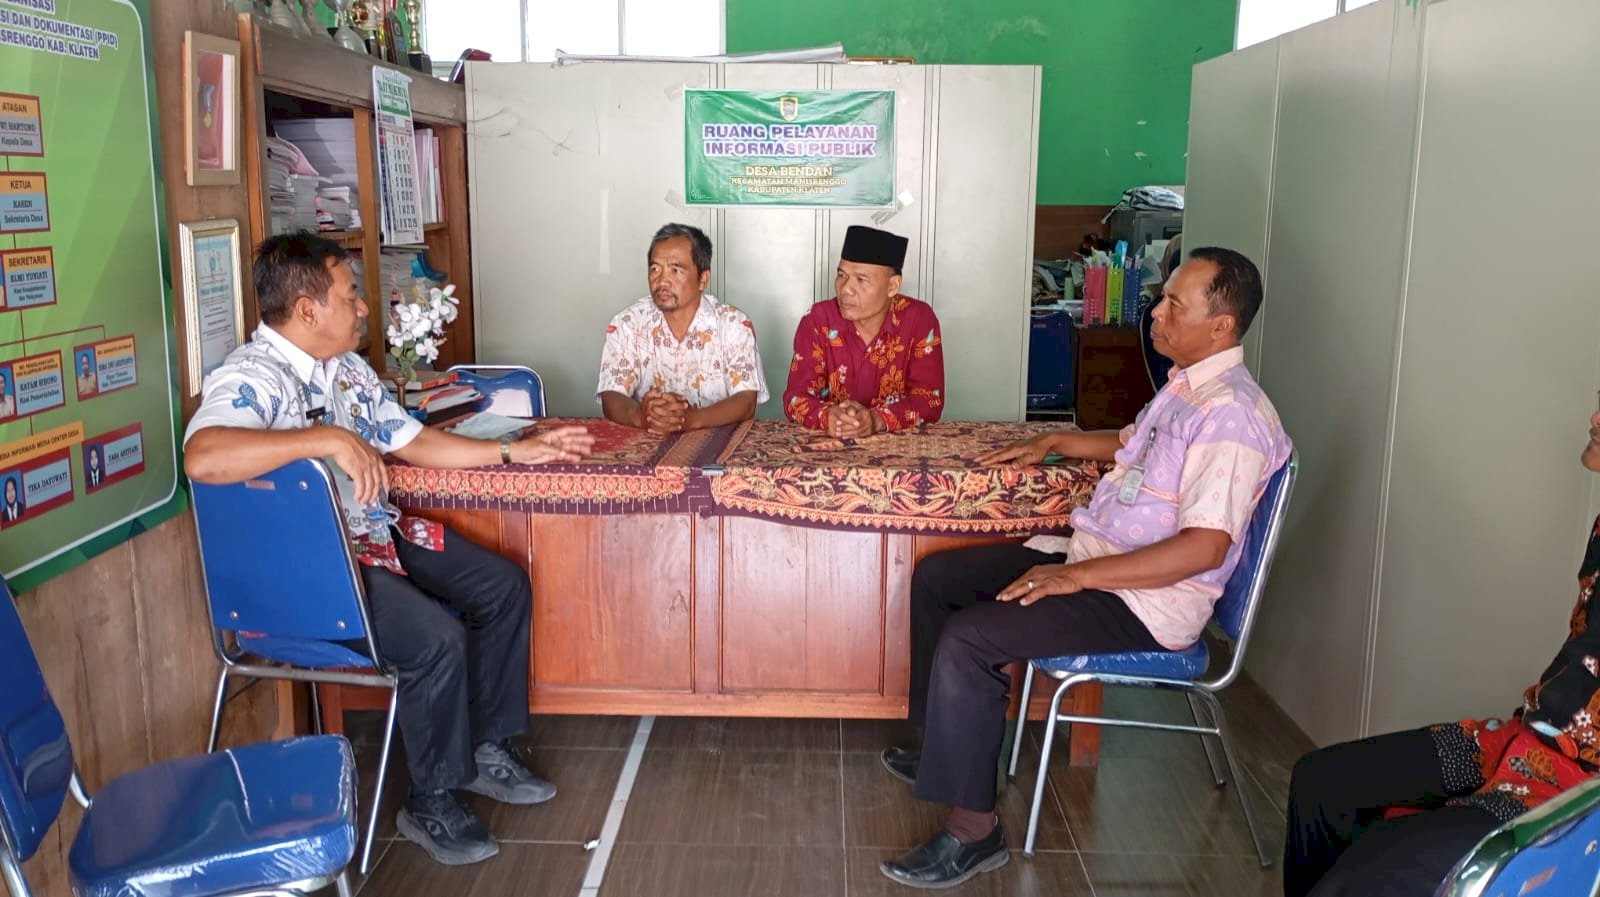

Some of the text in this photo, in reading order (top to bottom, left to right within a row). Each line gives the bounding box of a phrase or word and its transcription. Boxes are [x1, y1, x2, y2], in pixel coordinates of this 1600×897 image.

[12, 12, 32, 28] DAN
[33, 17, 94, 41] DOKUMENTASI
[95, 30, 118, 48] (PPID)
[0, 29, 99, 59] SRENGGO KAB. KLATEN
[2, 102, 28, 113] ATASAN
[703, 125, 875, 139] RUANG PELAYANAN
[705, 142, 875, 156] INFORMASI PUBLIK
[745, 166, 833, 176] DESA BENDAN
[10, 180, 32, 190] KETUA
[731, 177, 784, 185] KECAMATAN
[799, 186, 831, 194] KLATEN
[8, 254, 47, 268] SEKRETARIS
[36, 439, 51, 449] MEDIA
[51, 432, 68, 444] CENTER
[68, 429, 80, 438] DESA
